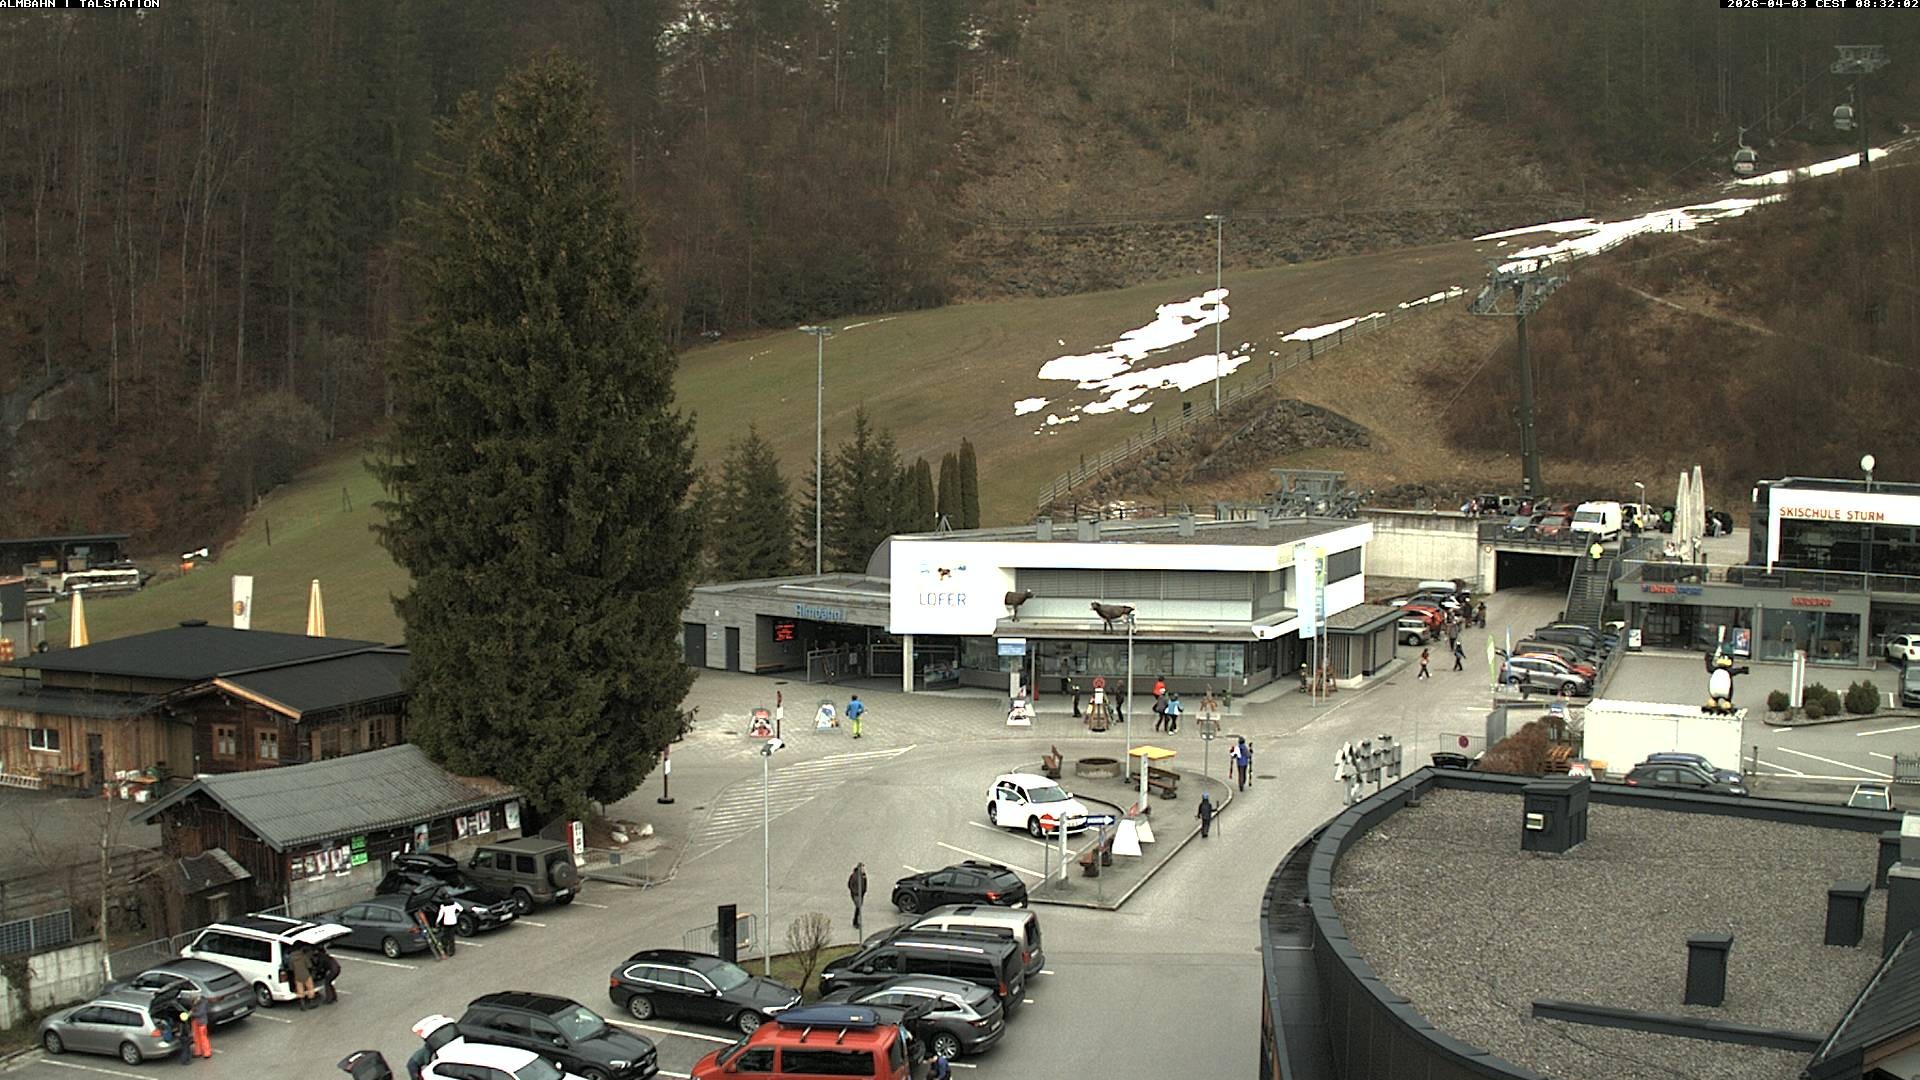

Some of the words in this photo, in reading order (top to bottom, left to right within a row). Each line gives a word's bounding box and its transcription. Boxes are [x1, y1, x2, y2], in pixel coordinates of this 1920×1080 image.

[1779, 506, 1841, 520] SKISCHULE
[1846, 510, 1885, 521] STURM
[919, 592, 967, 606] LOFER
